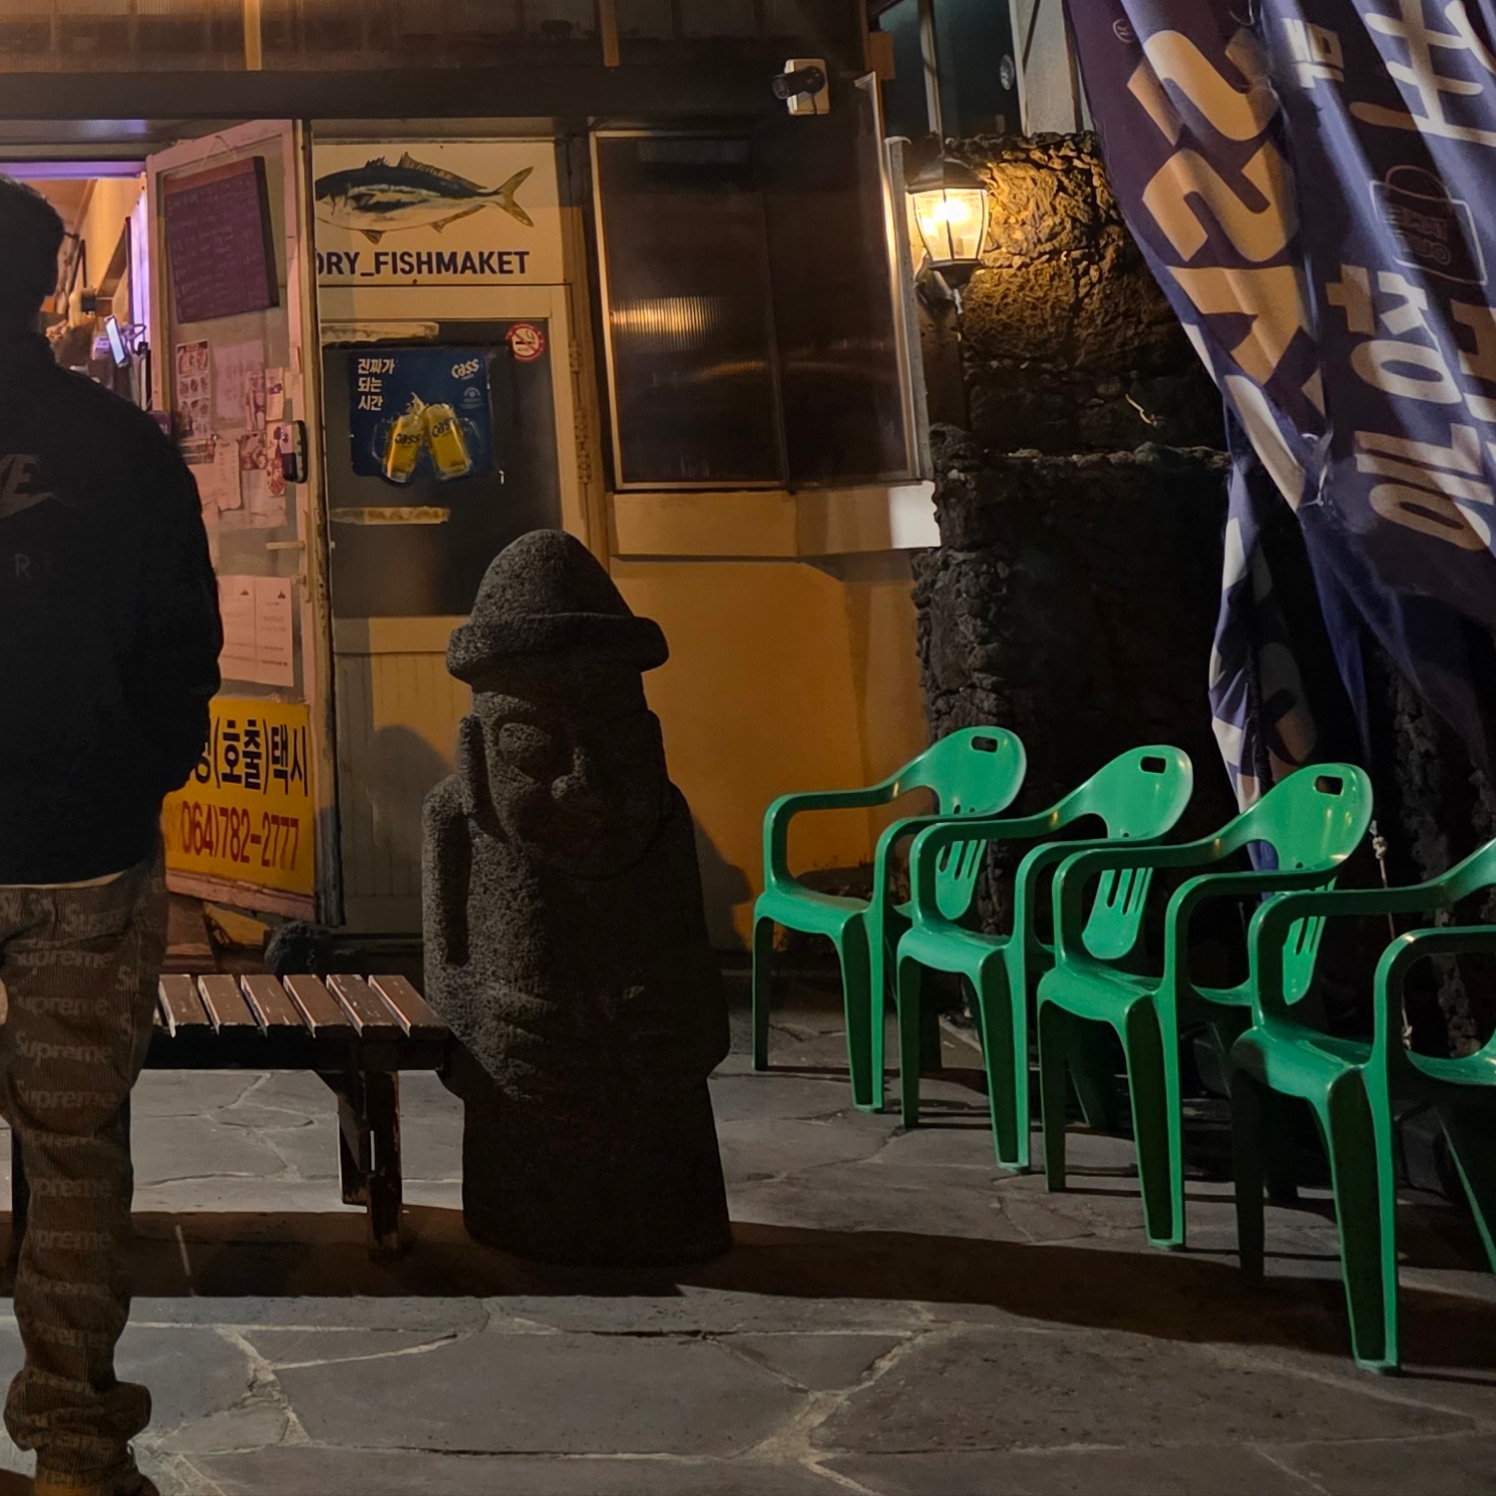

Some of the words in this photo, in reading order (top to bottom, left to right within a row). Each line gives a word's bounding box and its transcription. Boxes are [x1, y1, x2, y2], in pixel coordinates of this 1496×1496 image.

[357, 357, 396, 375] 진짜가
[357, 376, 382, 393] 되는
[357, 395, 384, 412] 시간
[15, 1030, 114, 1068] Supreme
